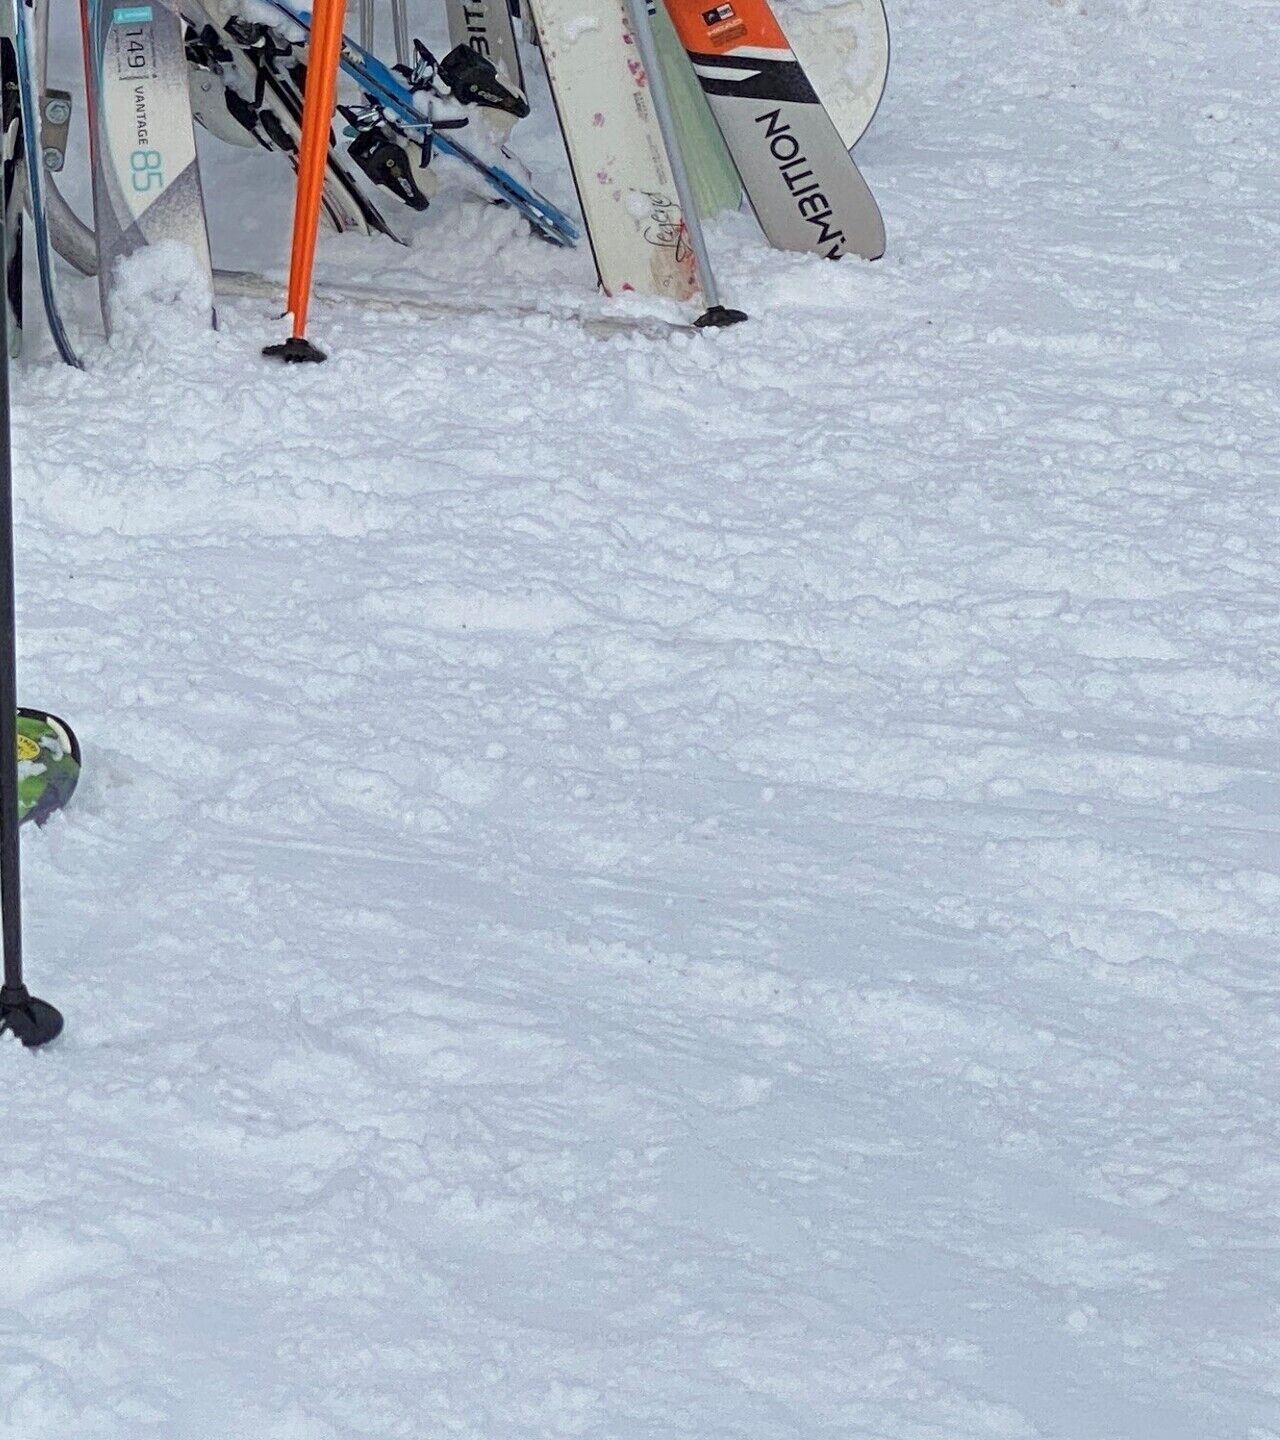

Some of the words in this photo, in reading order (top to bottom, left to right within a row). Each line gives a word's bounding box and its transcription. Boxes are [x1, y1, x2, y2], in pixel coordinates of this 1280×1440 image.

[125, 29, 147, 70] 149
[133, 85, 149, 146] VANTAGE
[129, 150, 163, 192] 85
